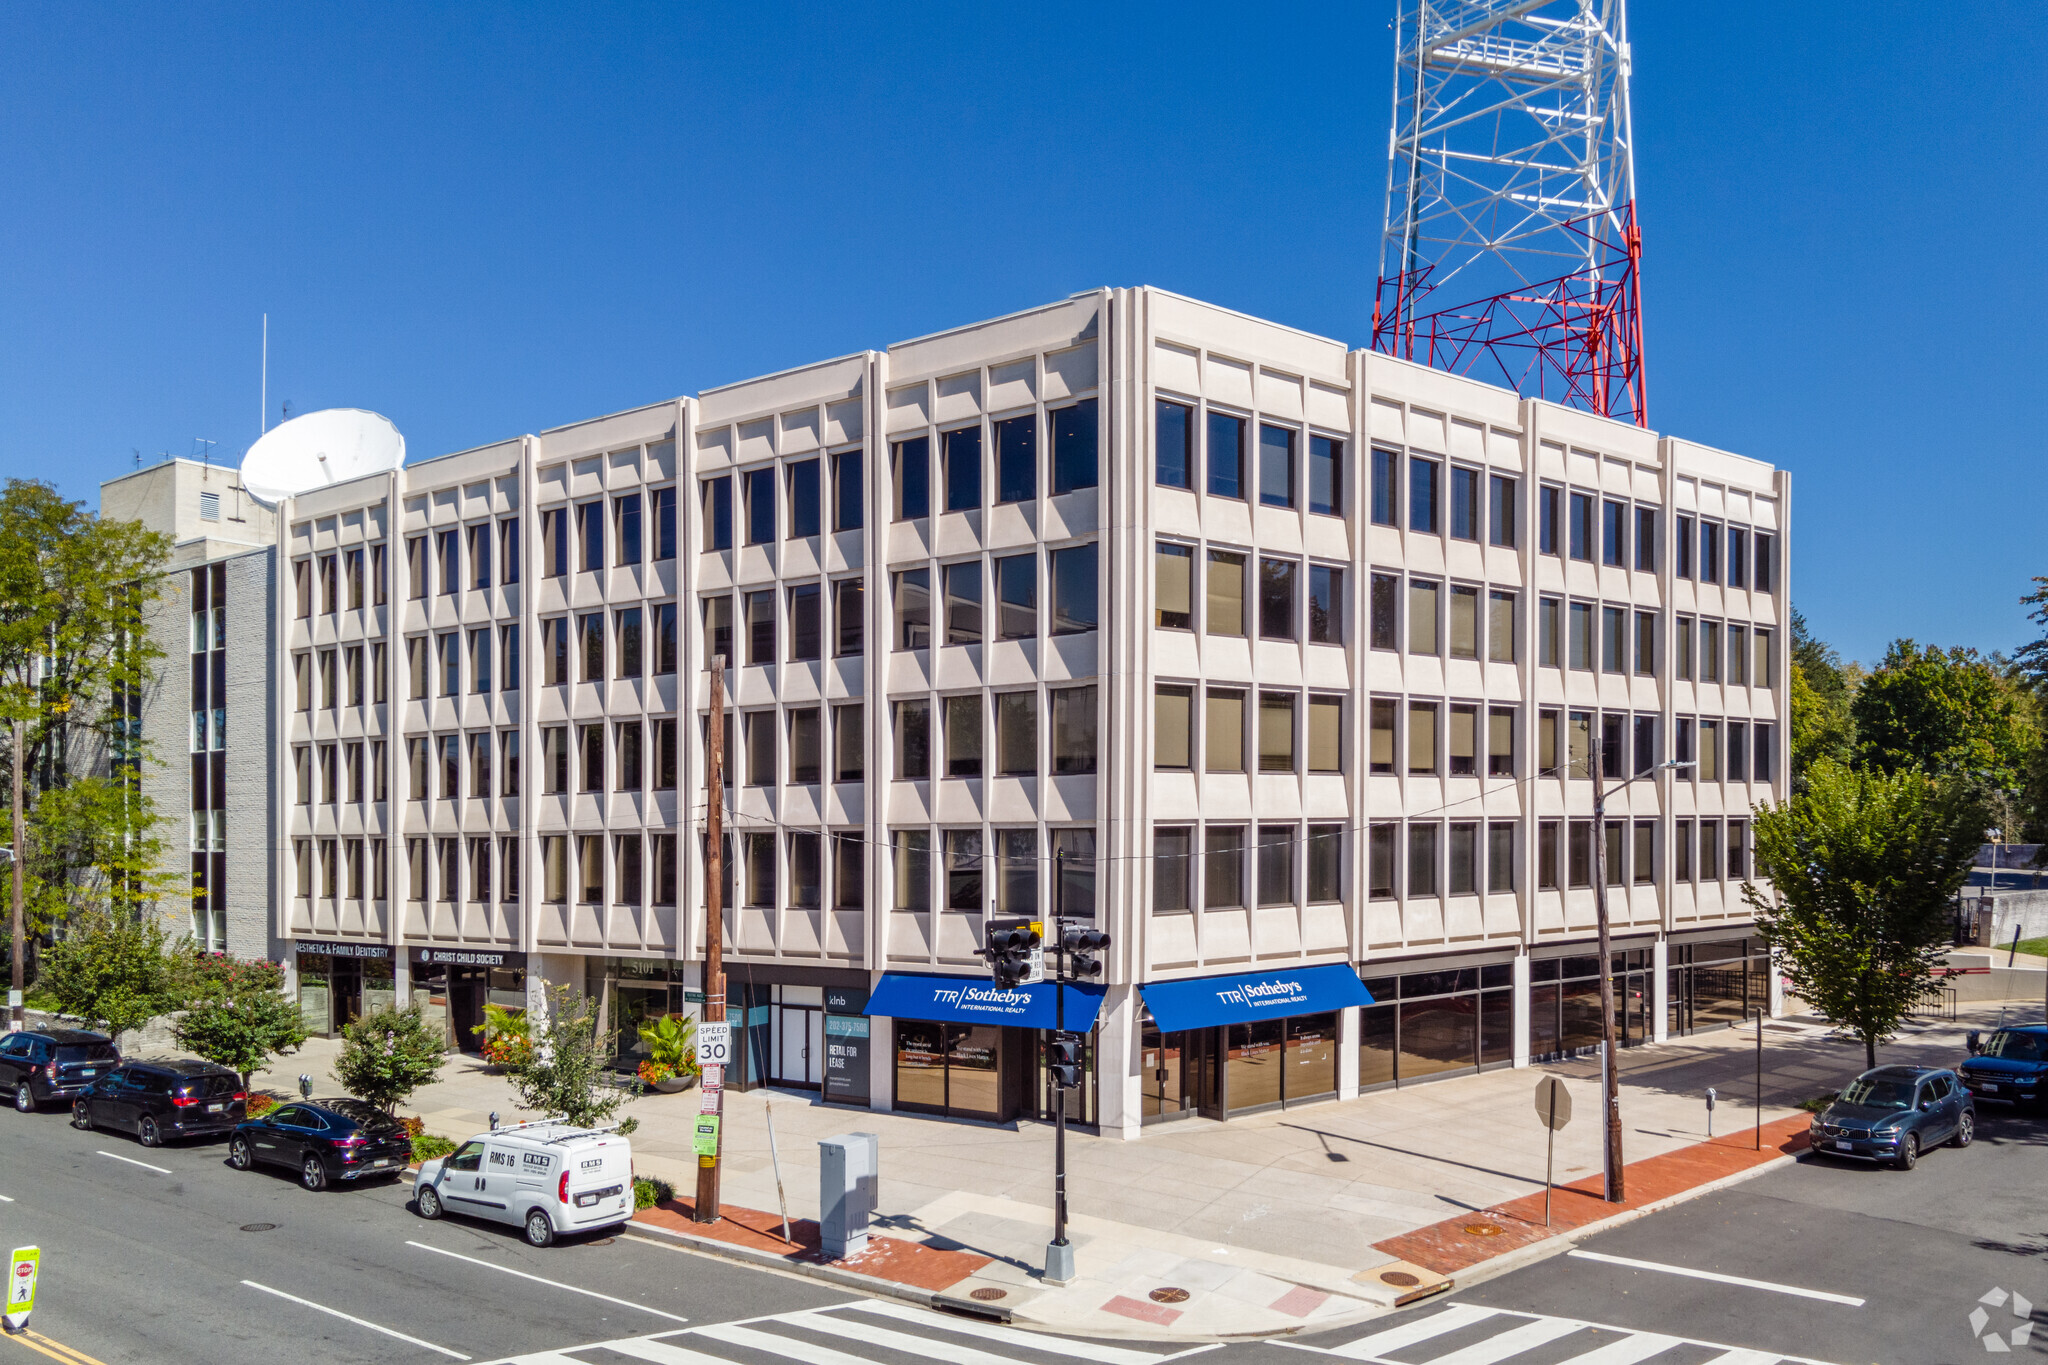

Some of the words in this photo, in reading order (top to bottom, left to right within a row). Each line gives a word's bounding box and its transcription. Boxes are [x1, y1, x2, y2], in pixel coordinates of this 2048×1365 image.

[296, 942, 324, 954] AESTHETIC
[326, 944, 332, 954] &
[332, 944, 354, 956] FAMILY
[355, 946, 388, 958] DENTISTRY
[434, 952, 456, 962] CHRIST
[457, 953, 476, 963] CHILD
[476, 954, 504, 965] SOCIETY
[632, 962, 654, 974] 5101
[934, 989, 959, 1003] TTR
[965, 988, 1032, 1006] Sotheby's
[1216, 990, 1244, 1004] TTR
[1244, 980, 1302, 997] Sotheby's
[829, 995, 846, 1006] klnb
[1253, 997, 1292, 1007] INTERNATIONAL
[960, 1004, 1004, 1012] INTERNATIONAL
[701, 1044, 726, 1059] 30
[829, 1045, 846, 1056] RETAIL
[846, 1046, 857, 1057] FOR
[829, 1057, 845, 1068] LEASE
[490, 1152, 505, 1167] RMS
[506, 1155, 515, 1167] 16
[524, 1154, 549, 1166] RMS
[582, 1159, 601, 1168] RMS
